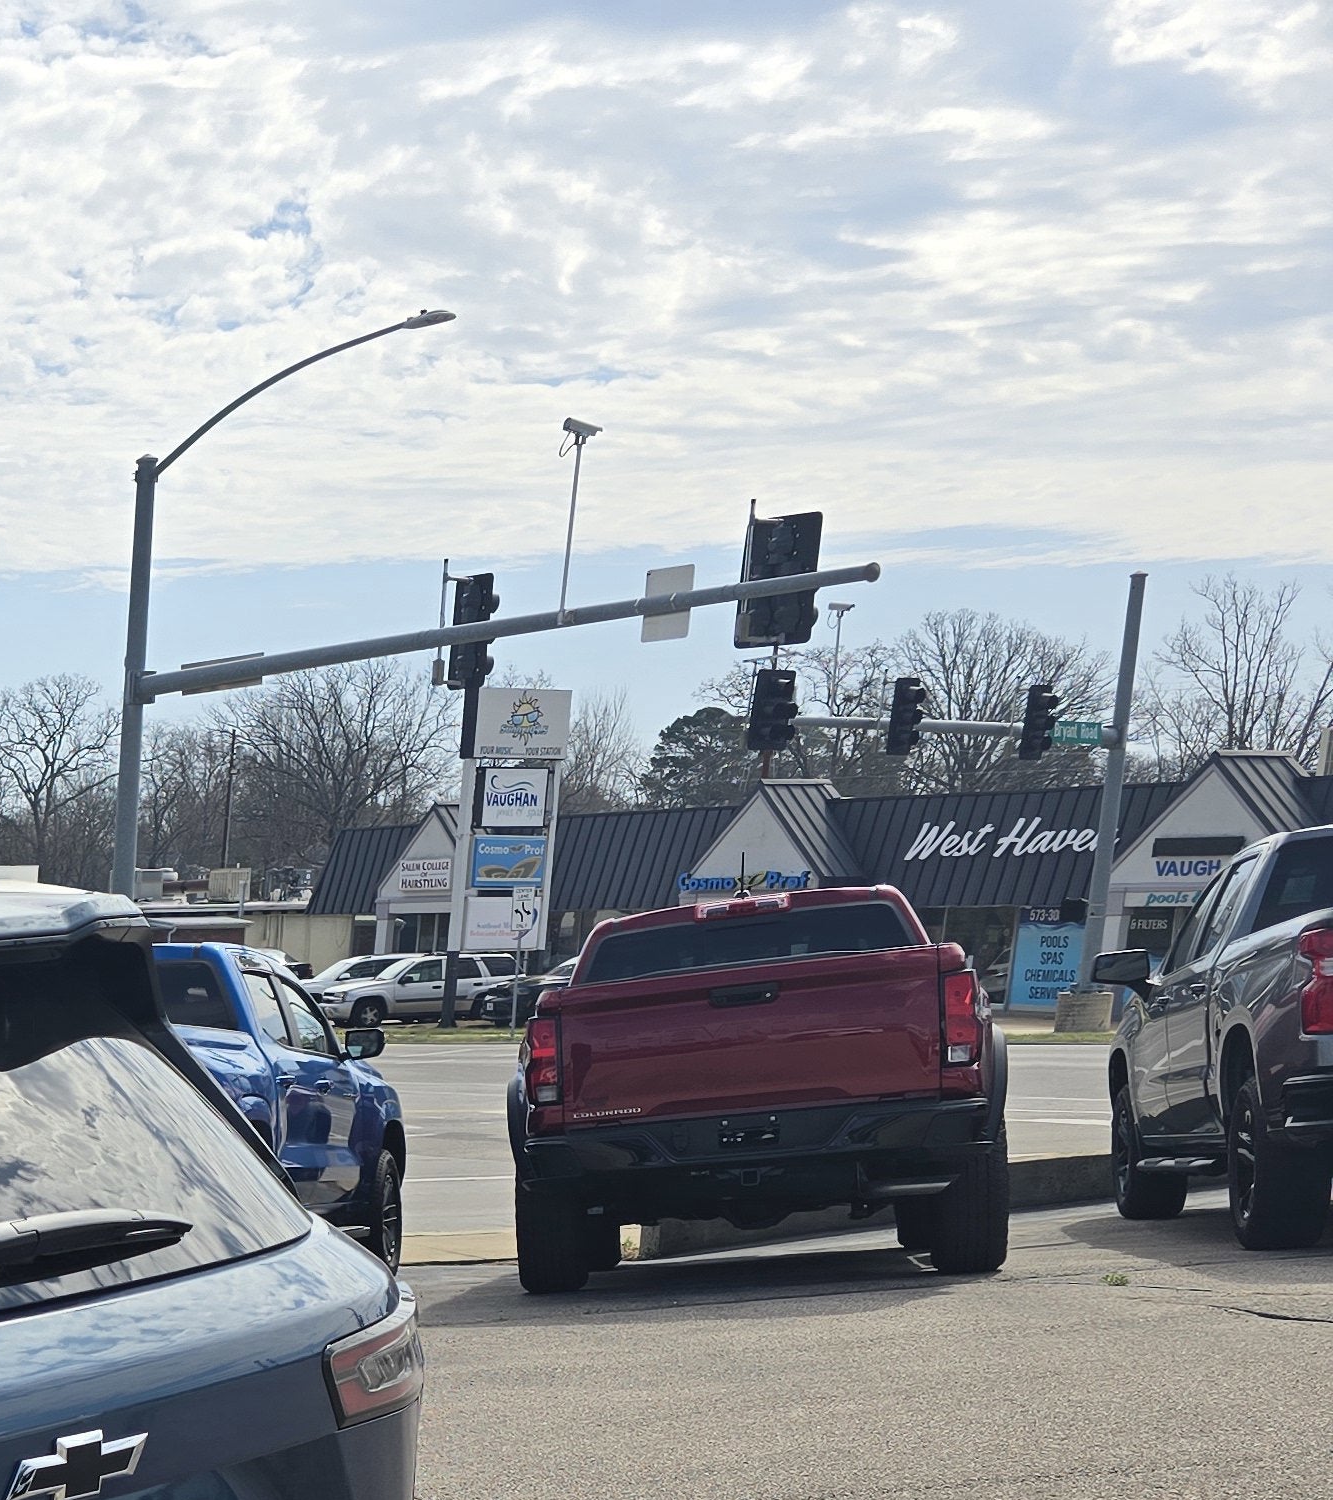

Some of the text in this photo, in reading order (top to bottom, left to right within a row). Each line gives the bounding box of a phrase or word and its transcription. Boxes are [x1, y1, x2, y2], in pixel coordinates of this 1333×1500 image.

[1053, 721, 1098, 741] Bryant Road
[486, 791, 538, 807] VAUGHAN
[903, 820, 995, 861] West
[478, 843, 545, 855] Cosmo Prof
[1155, 859, 1221, 877] VAUGH
[677, 870, 812, 891] Cosmo Prof
[1145, 891, 1189, 907] pools
[1029, 909, 1060, 921] 573-30
[1137, 918, 1168, 930] FILTERS
[1040, 936, 1070, 948] POOLS
[1040, 952, 1065, 965] SPAS
[1024, 968, 1076, 982] CHEMICALS
[572, 1107, 642, 1119] COLORADO
